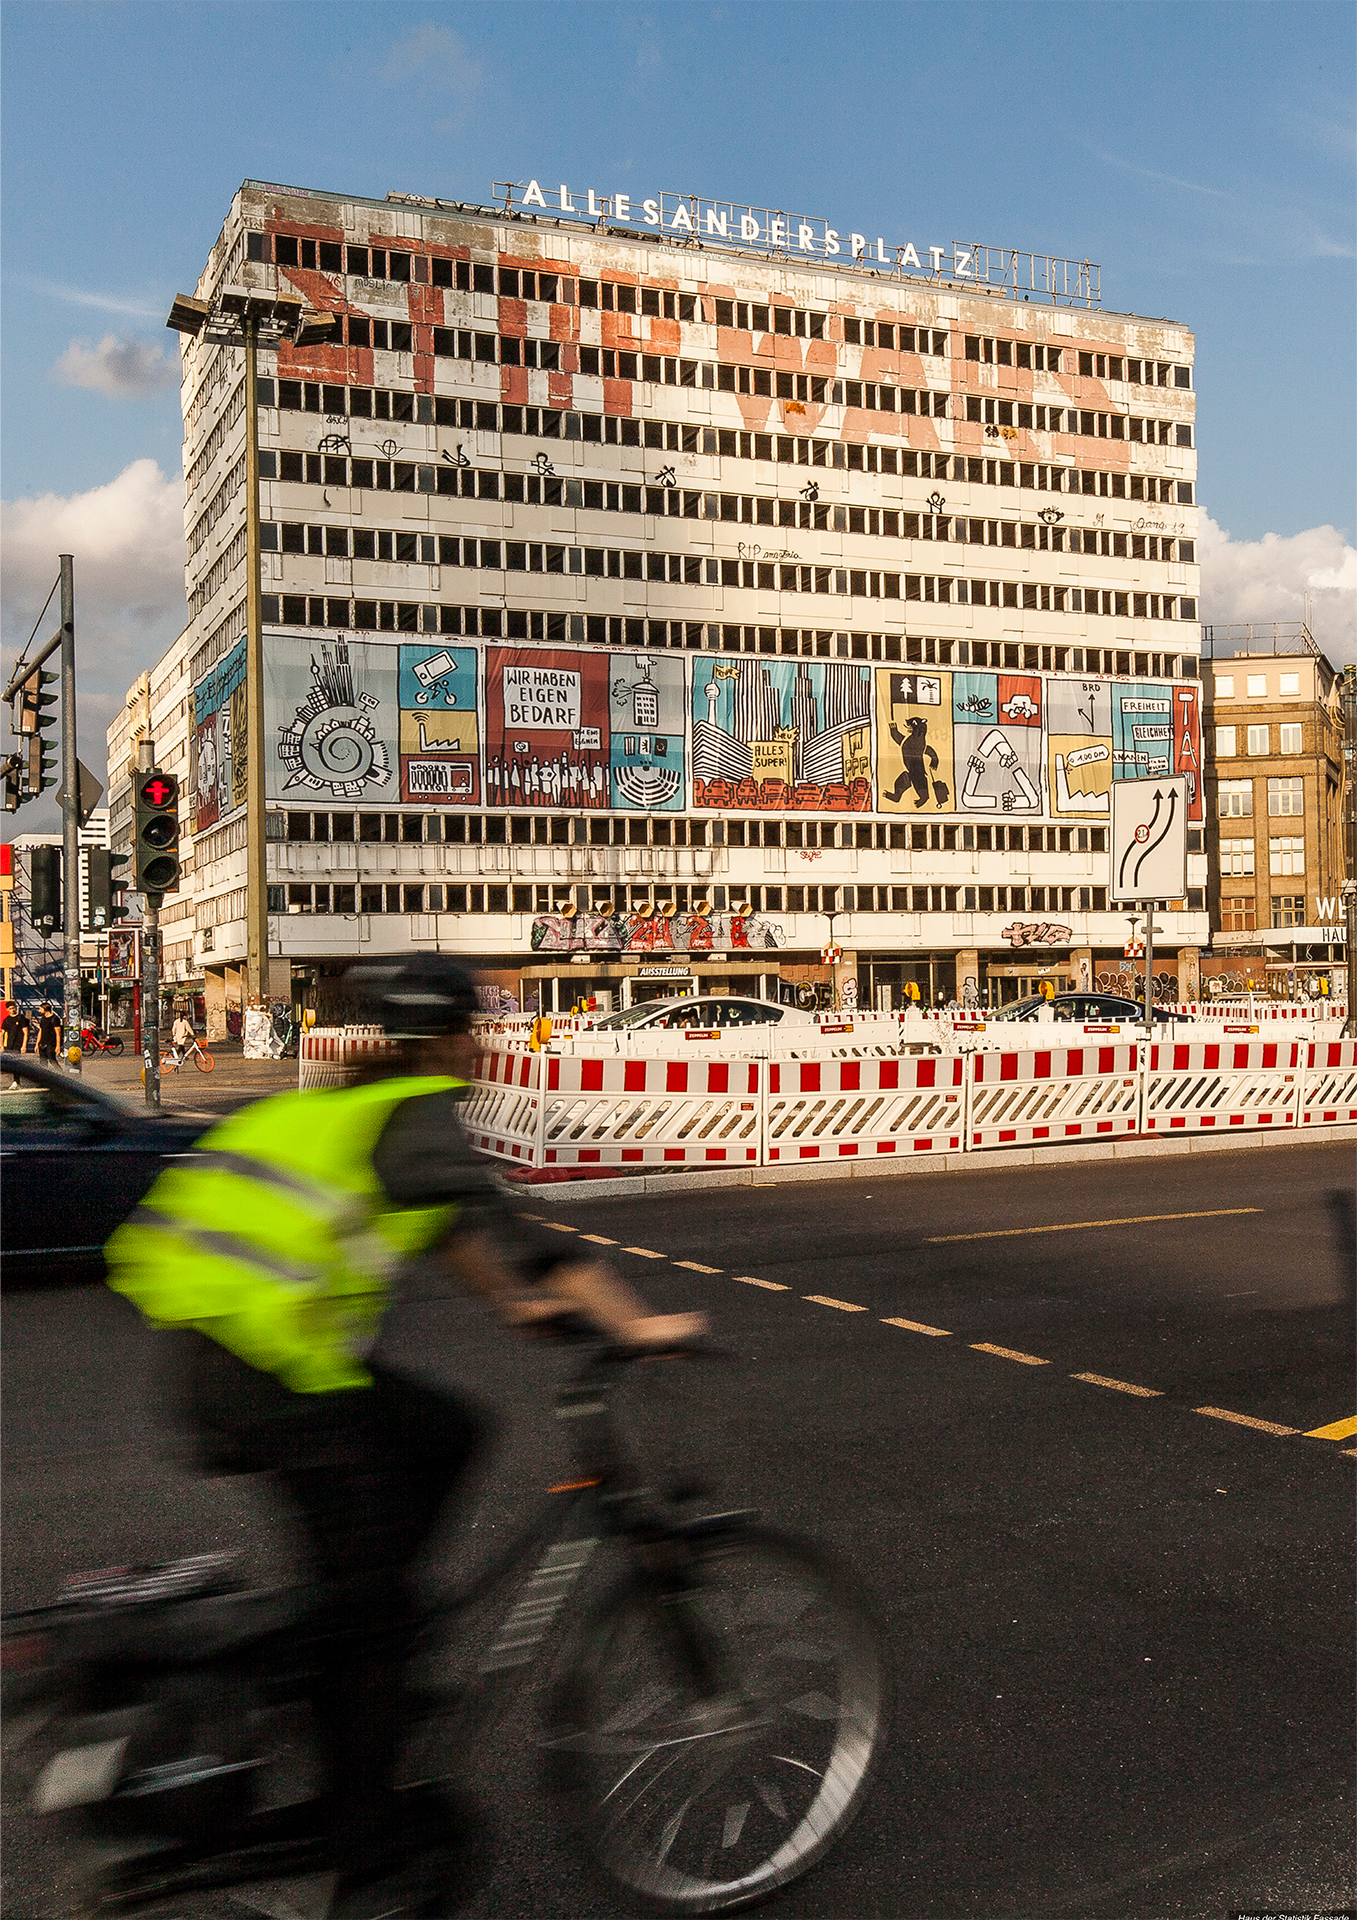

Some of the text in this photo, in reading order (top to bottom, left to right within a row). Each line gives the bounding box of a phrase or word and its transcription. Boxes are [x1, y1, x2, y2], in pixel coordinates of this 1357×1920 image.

[522, 179, 972, 276] ALLESANDERSPLATZ
[738, 541, 762, 559] RIP
[507, 669, 576, 687] WIR HABEN
[1082, 683, 1101, 692] BRD
[520, 687, 567, 703] EIGEN
[1123, 701, 1166, 712] FREIHEIT
[510, 704, 576, 725] BEDARF
[754, 745, 784, 756] ALLES
[754, 757, 788, 768] SUPER!
[640, 966, 689, 976] AUSSTELLUNG
